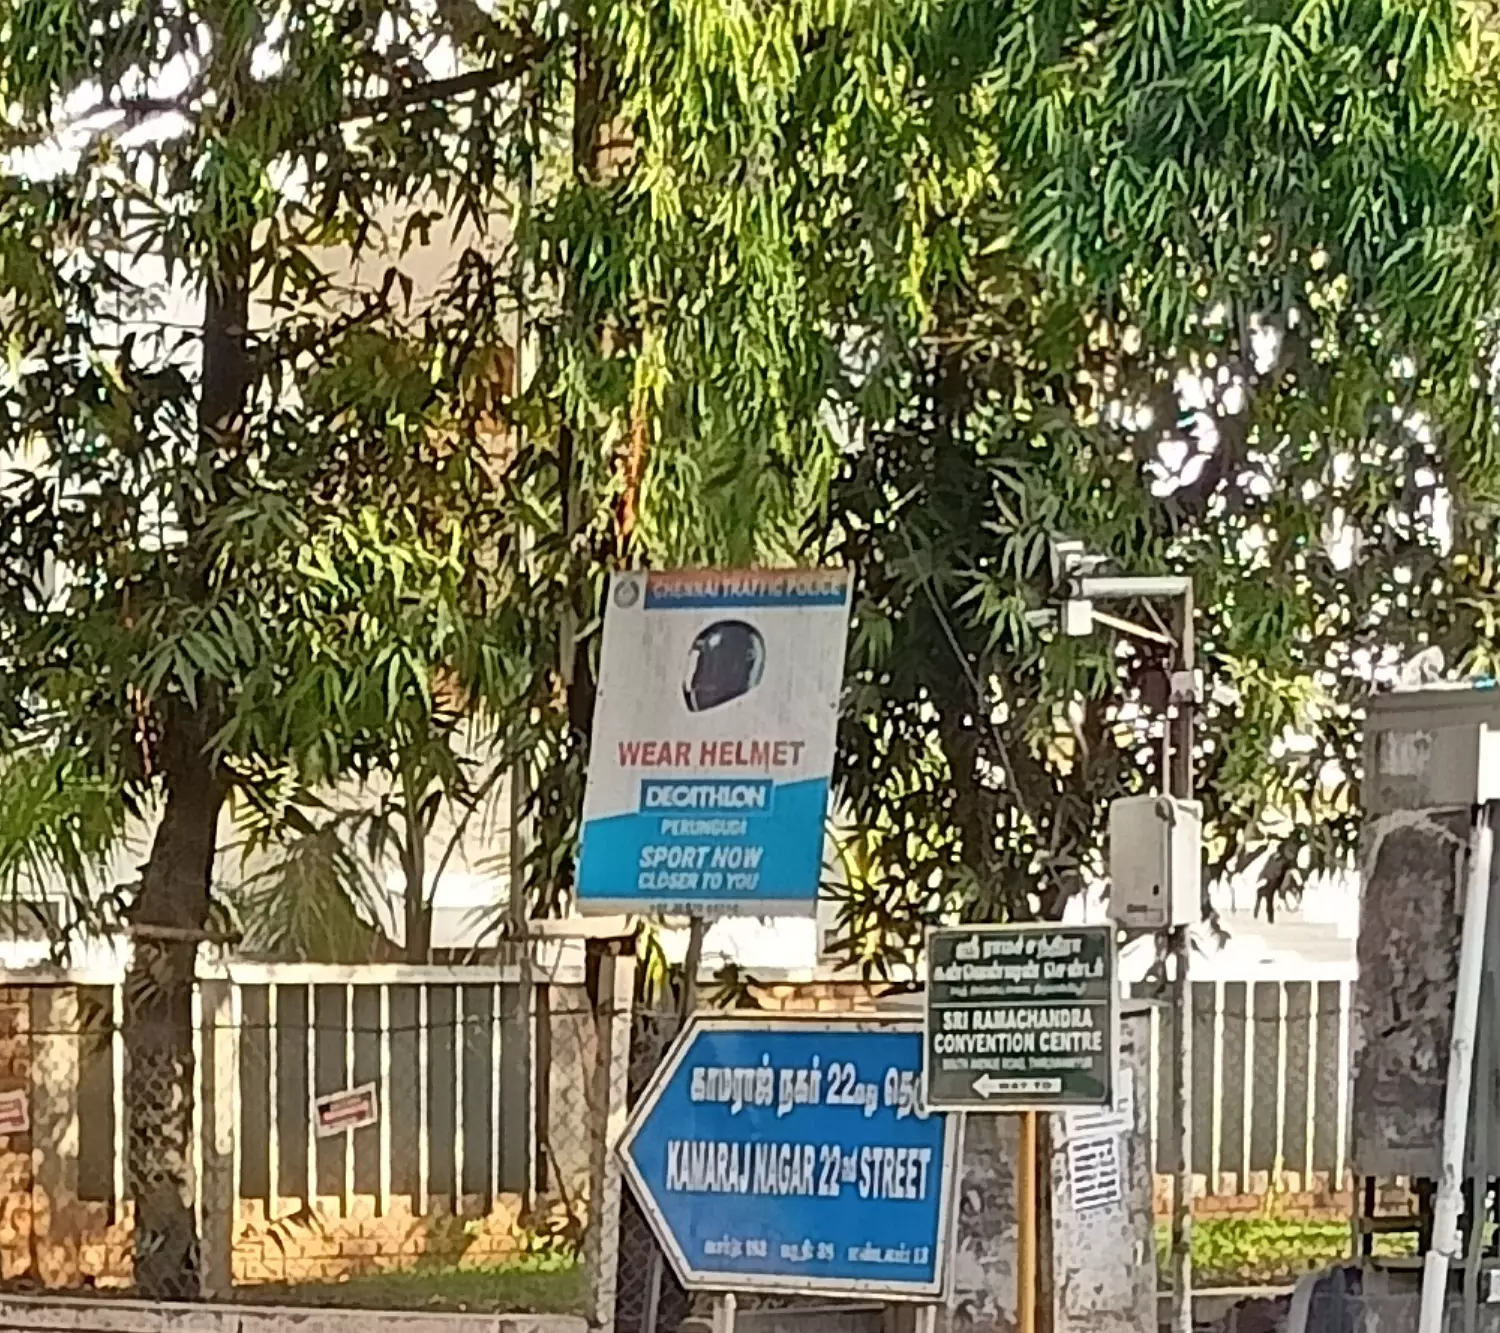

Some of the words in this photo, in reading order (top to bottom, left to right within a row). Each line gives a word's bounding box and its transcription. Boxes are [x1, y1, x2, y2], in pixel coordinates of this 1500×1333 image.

[618, 740, 692, 767] WEAR
[700, 740, 806, 768] HELMET
[645, 785, 766, 808] DECATHLON
[639, 845, 711, 869] SPORT
[711, 846, 764, 869] NOW
[637, 872, 699, 890] CLOSER
[702, 872, 723, 890] TO
[726, 872, 760, 890] YOU
[943, 1010, 969, 1030] SRI
[972, 1008, 1093, 1030] RAMACHANDRA
[934, 1032, 1036, 1054] CONVENTION
[1039, 1031, 1102, 1053] CENTRE
[777, 1054, 822, 1118] நகர்
[666, 1140, 751, 1194] KAMARAJ
[753, 1142, 815, 1196] NAGAR
[818, 1144, 858, 1197] 22nd
[858, 1146, 932, 1200] STREET
